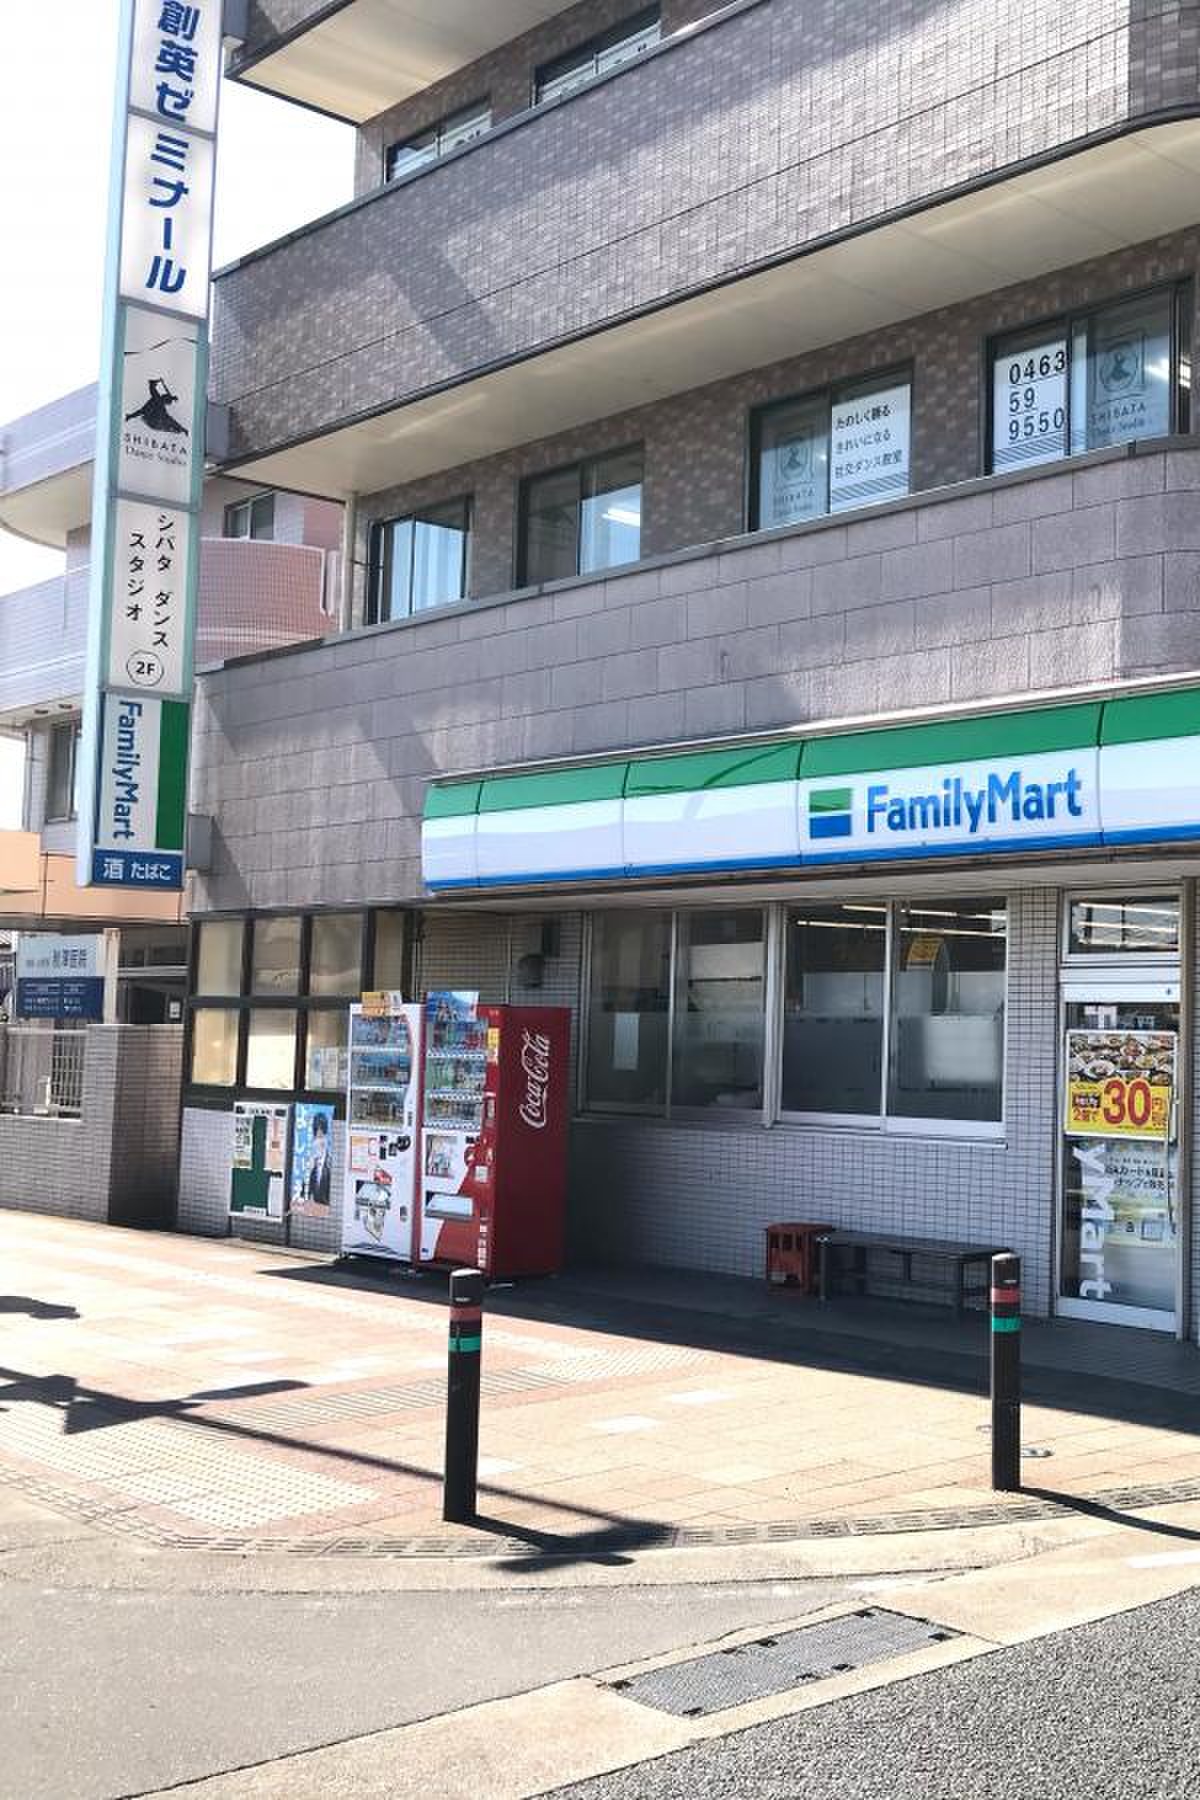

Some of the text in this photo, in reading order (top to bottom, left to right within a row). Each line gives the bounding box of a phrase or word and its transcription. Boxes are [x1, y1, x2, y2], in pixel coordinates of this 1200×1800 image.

[1008, 350, 1066, 385] 0463
[1008, 387, 1036, 413] 59
[1008, 407, 1065, 440] 9550
[124, 532, 146, 622] スタジオ
[152, 513, 176, 648] シバタ ダンス
[135, 661, 156, 676] 2F
[112, 700, 143, 841] FamilyMart
[867, 767, 1083, 833] FamilyMart
[102, 857, 172, 881] 酒 たばこ
